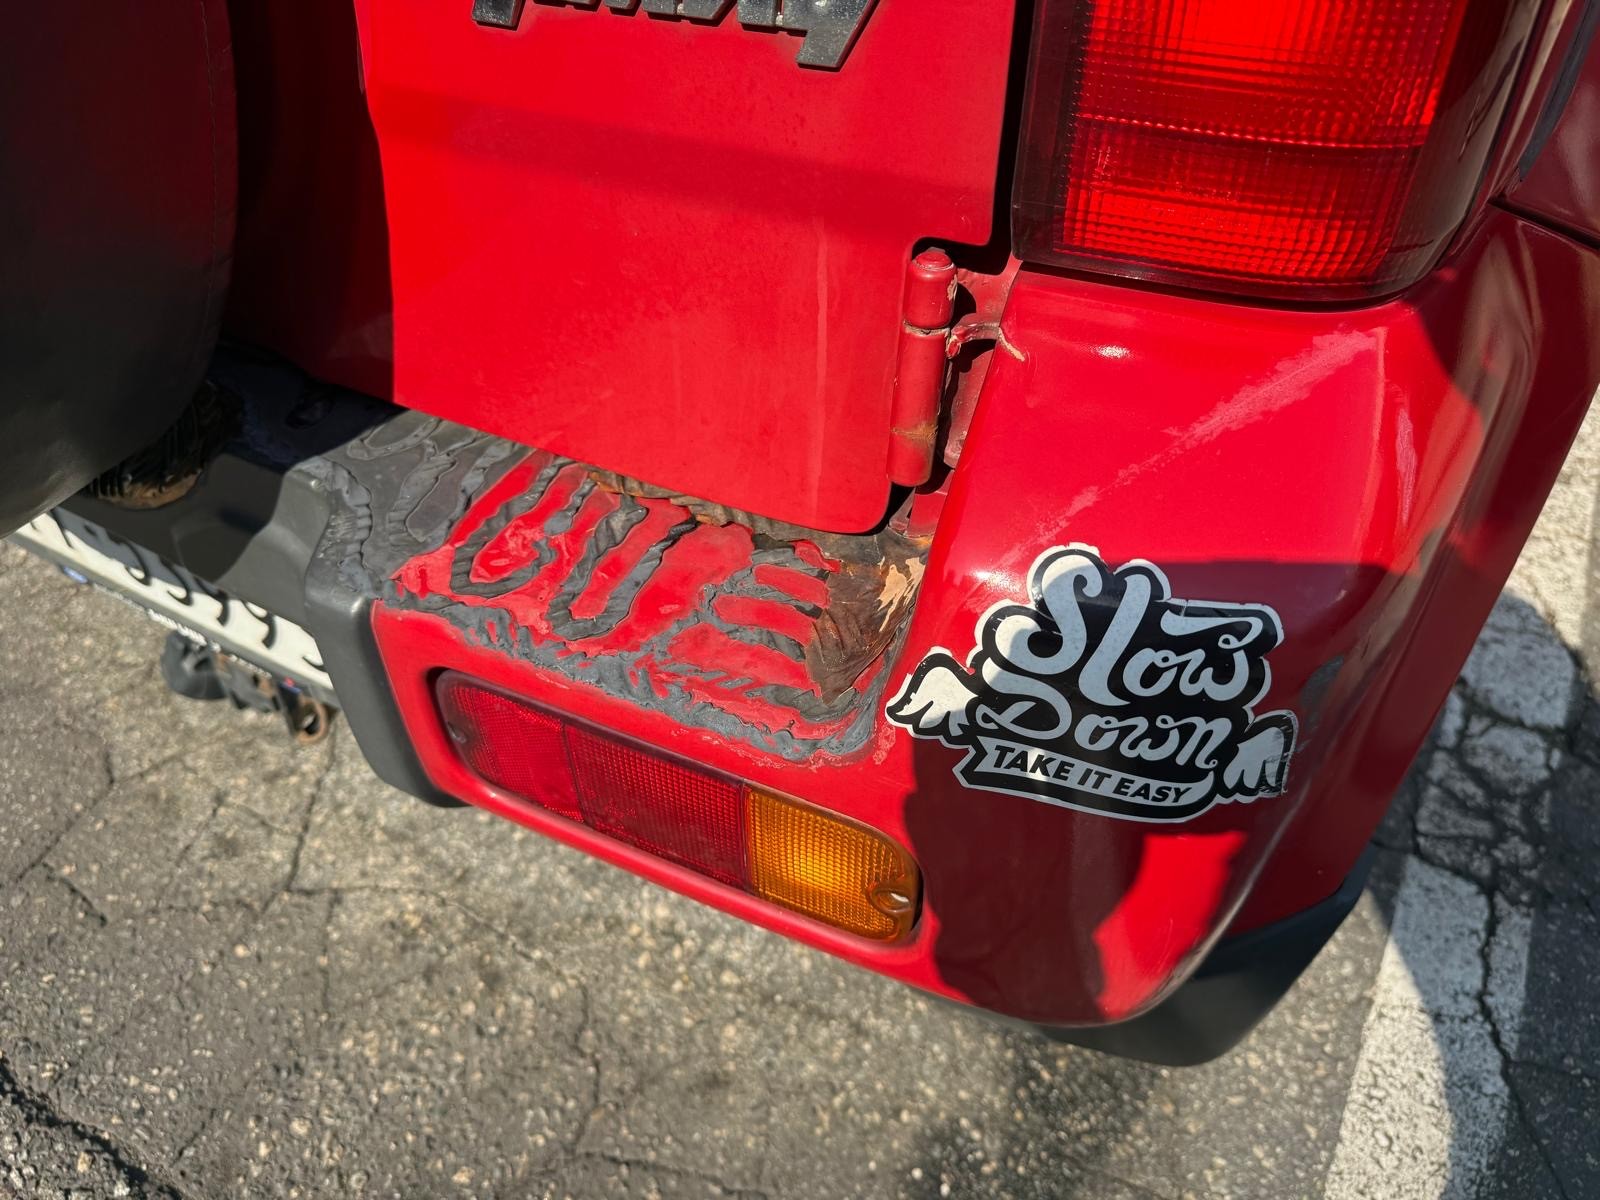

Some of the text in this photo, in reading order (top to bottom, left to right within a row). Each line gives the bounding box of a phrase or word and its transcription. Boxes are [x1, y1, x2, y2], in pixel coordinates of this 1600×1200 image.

[995, 554, 1263, 706] Slow
[976, 657, 1232, 769] Down
[993, 744, 1193, 803] TAKE IT EASY
